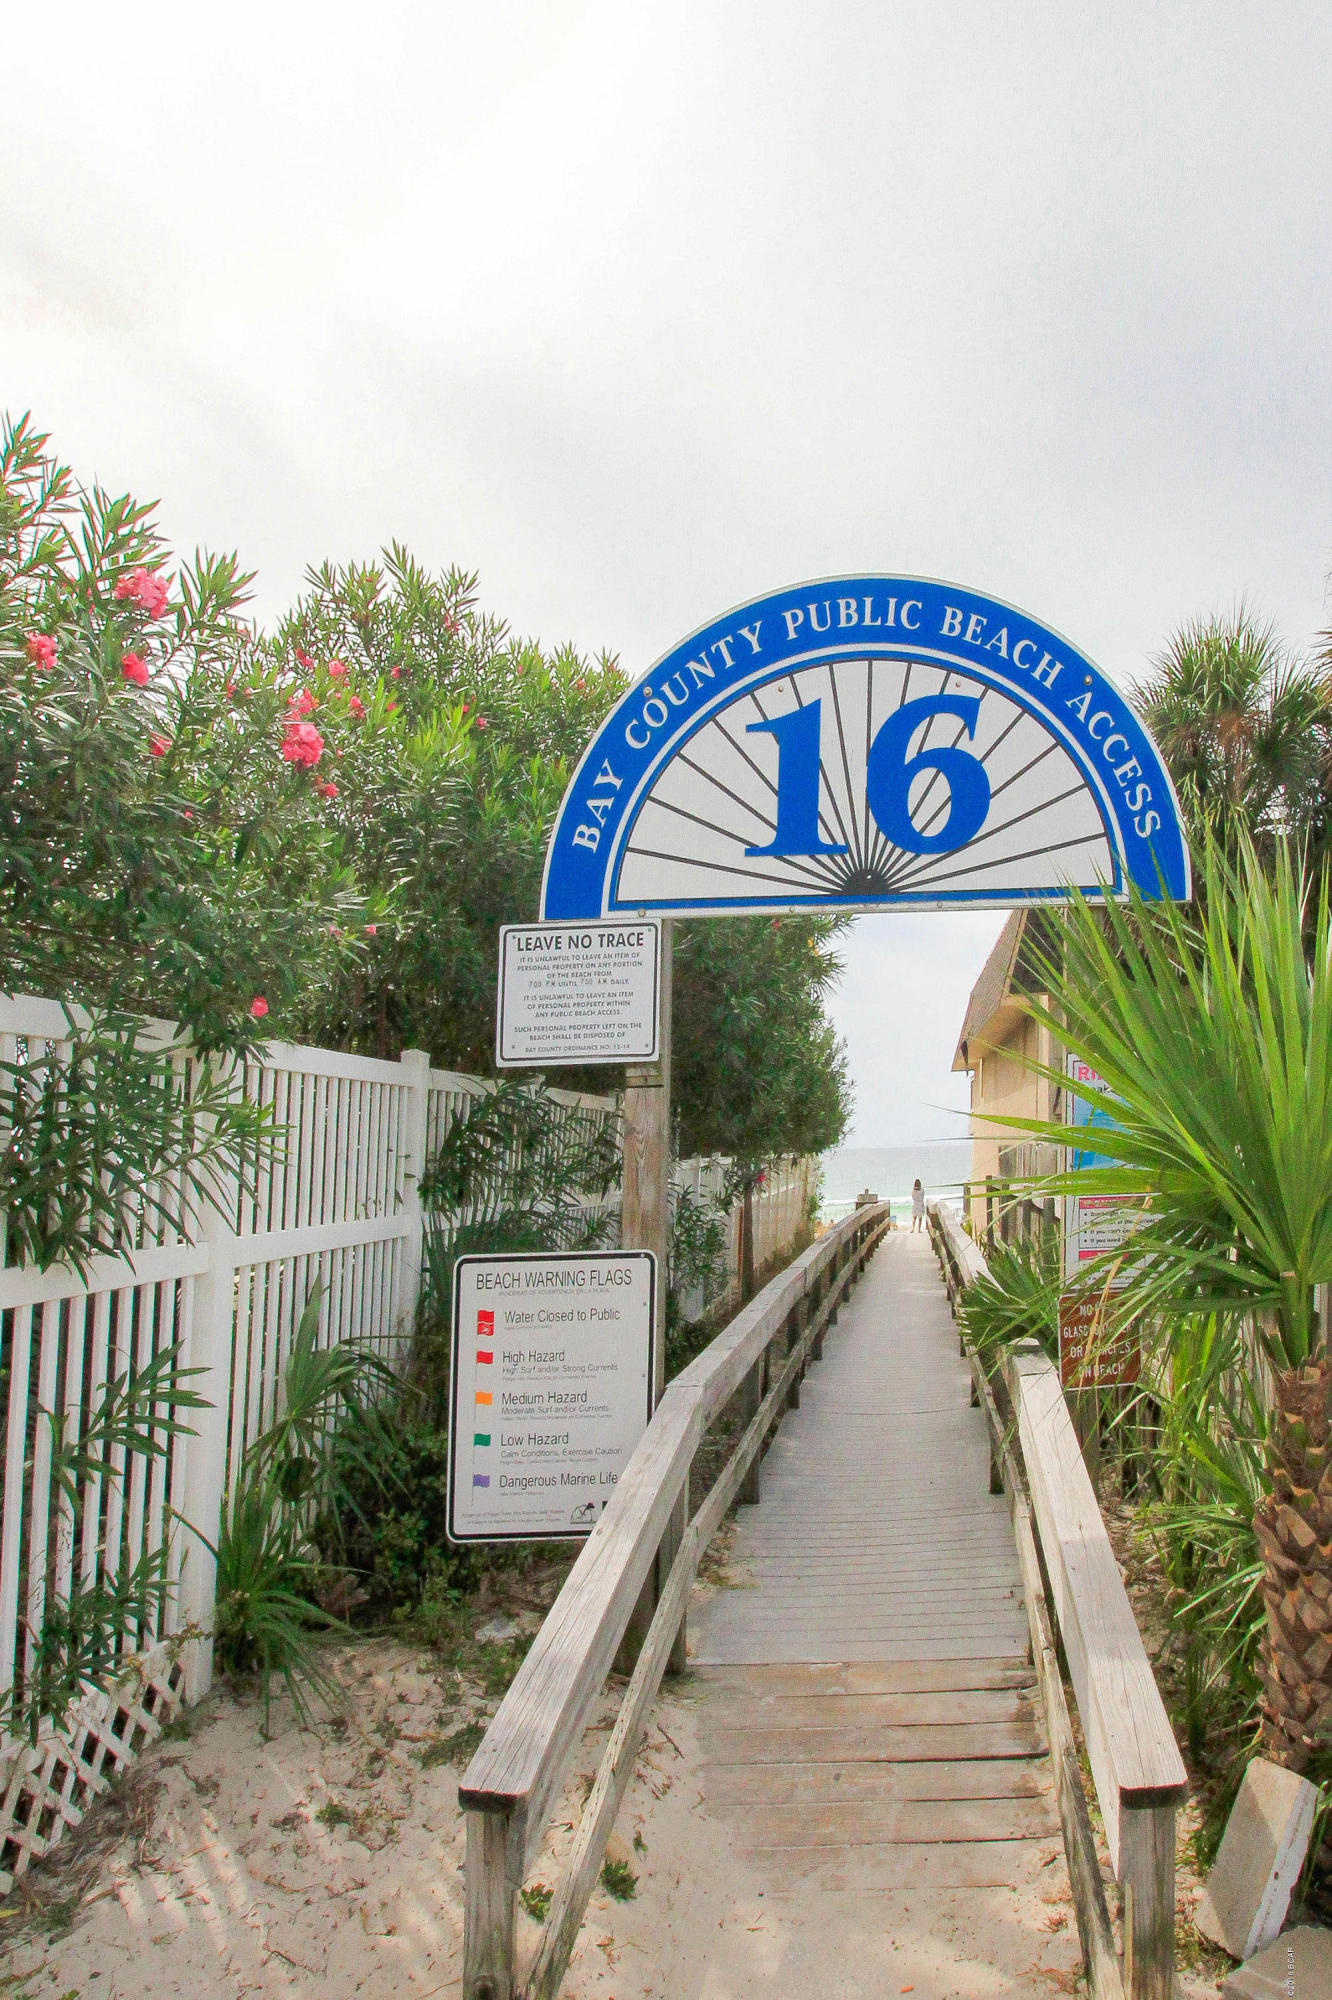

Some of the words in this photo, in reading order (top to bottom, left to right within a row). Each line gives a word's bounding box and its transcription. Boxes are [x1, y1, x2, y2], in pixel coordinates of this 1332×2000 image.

[572, 757, 625, 854] BAY
[624, 621, 764, 751] COUNTY
[782, 597, 923, 641] PUBLIC
[938, 605, 1064, 690] BEACH
[1065, 689, 1162, 840] ACCESS
[744, 693, 991, 857] 16
[517, 936, 562, 951] LEAVE
[568, 934, 592, 949] NO
[598, 932, 644, 948] TRACE
[476, 1272, 521, 1290] BEACH
[525, 1270, 586, 1288] WARNING
[590, 1269, 632, 1286] FLAGS
[504, 1311, 535, 1324] Water
[538, 1309, 574, 1323] Closed
[577, 1309, 587, 1321] to
[590, 1308, 620, 1321] Public
[1080, 1305, 1092, 1316] NO
[502, 1351, 525, 1366] High
[528, 1350, 565, 1363] Hazard
[1070, 1346, 1083, 1359] OR
[502, 1366, 519, 1375] High
[522, 1365, 536, 1373] Surf
[562, 1363, 586, 1374] Strong
[588, 1363, 618, 1372] Currents
[502, 1392, 544, 1405] Medium
[548, 1390, 587, 1403] Hazard
[501, 1407, 535, 1415] Moderate
[538, 1405, 552, 1414] Surf
[579, 1404, 609, 1413] Currents
[501, 1434, 523, 1447] Low
[528, 1432, 569, 1446] Hazard
[501, 1450, 519, 1458] Calm
[563, 1448, 593, 1456] Exercise
[595, 1447, 623, 1455] Caution
[499, 1474, 557, 1490] Dangerous
[560, 1472, 596, 1486] Marine
[599, 1472, 618, 1485] Life
